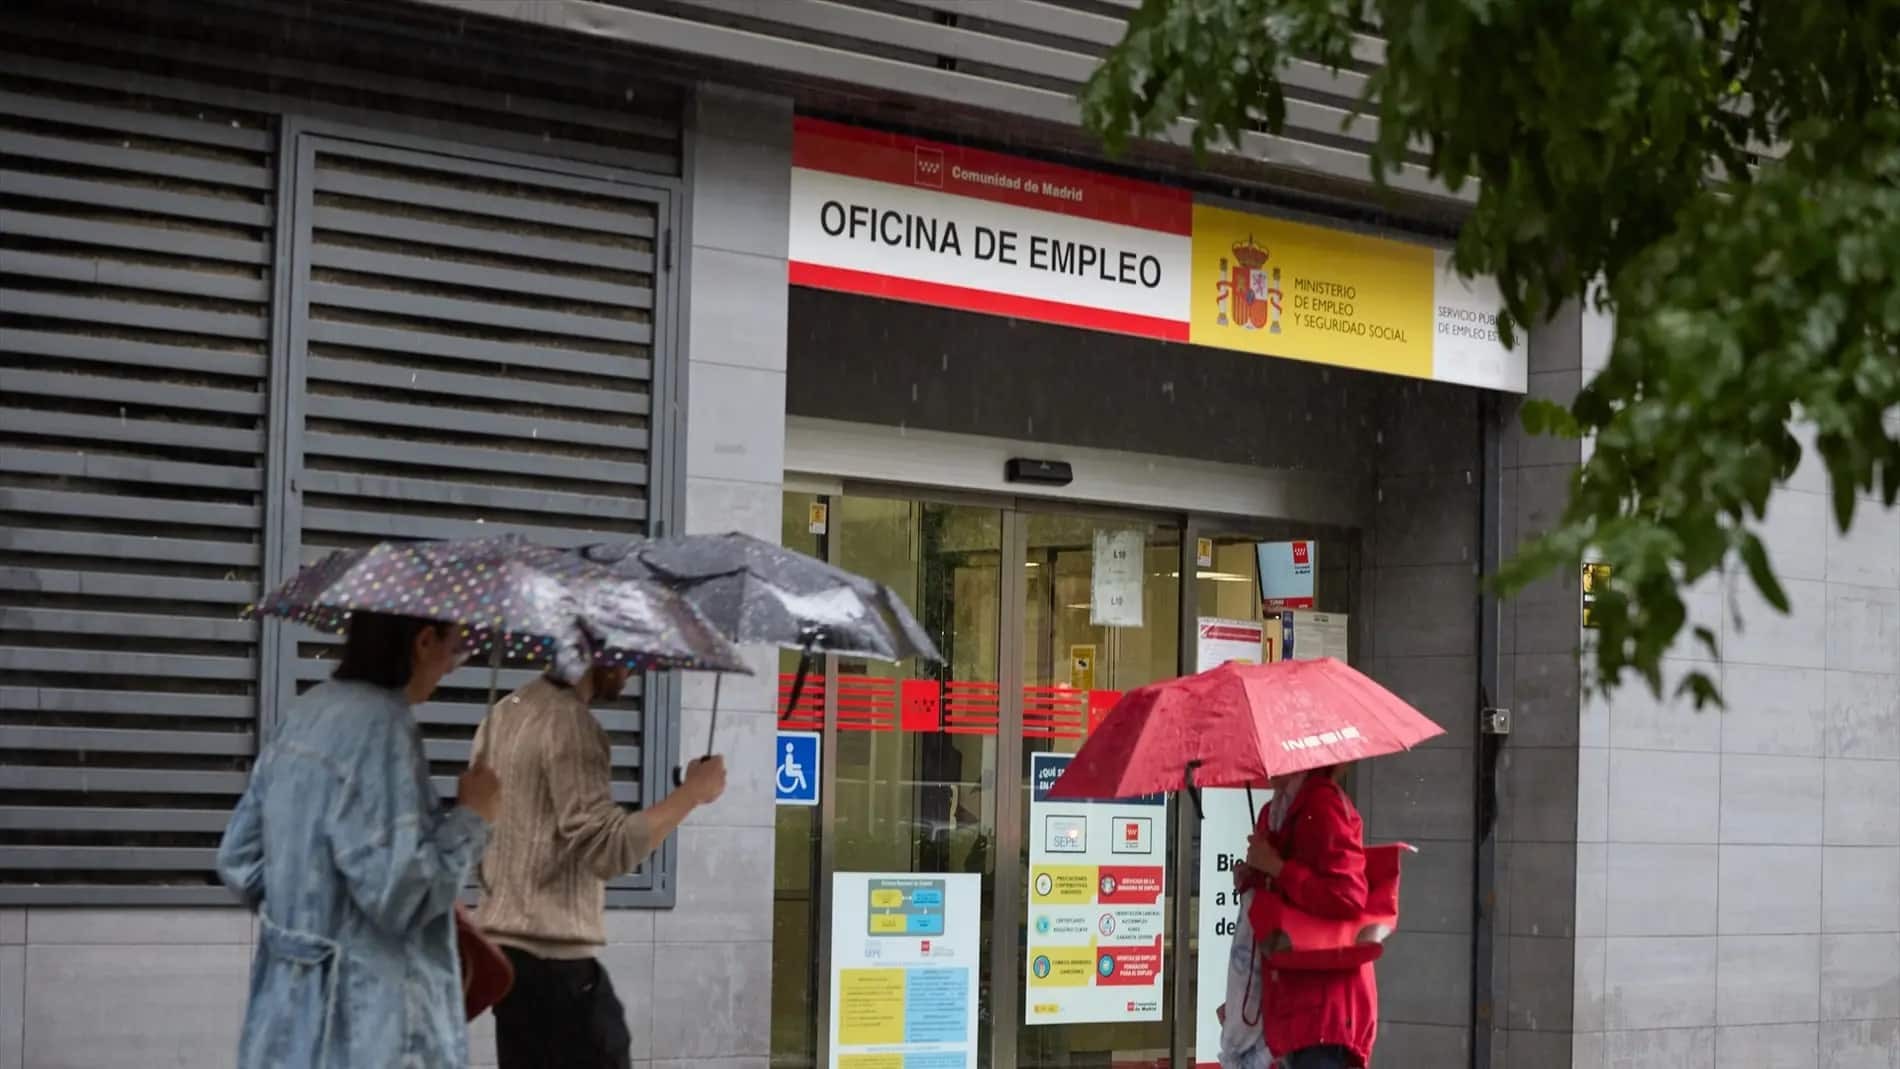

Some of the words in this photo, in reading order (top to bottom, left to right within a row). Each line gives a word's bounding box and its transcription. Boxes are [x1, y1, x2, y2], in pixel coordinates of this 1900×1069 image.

[951, 165, 1021, 191] Comunidad
[1024, 179, 1039, 193] de
[1042, 183, 1083, 202] Madrid
[820, 200, 962, 257] OFICINA
[974, 226, 1018, 265] DE
[1030, 235, 1162, 288] EMPLEO
[1294, 277, 1356, 300] MINISTERIO
[1294, 294, 1309, 310] DE
[1312, 297, 1354, 317] EMPLEO
[1437, 305, 1477, 322] SERVICIO
[1294, 312, 1301, 326] Y
[1303, 313, 1367, 337] SEGURIDAD
[1368, 323, 1408, 343] SOCIAL
[1438, 321, 1449, 335] DE
[1452, 324, 1486, 340] EMPLEO
[1488, 329, 1521, 346] ESAL
[1215, 891, 1226, 906] a
